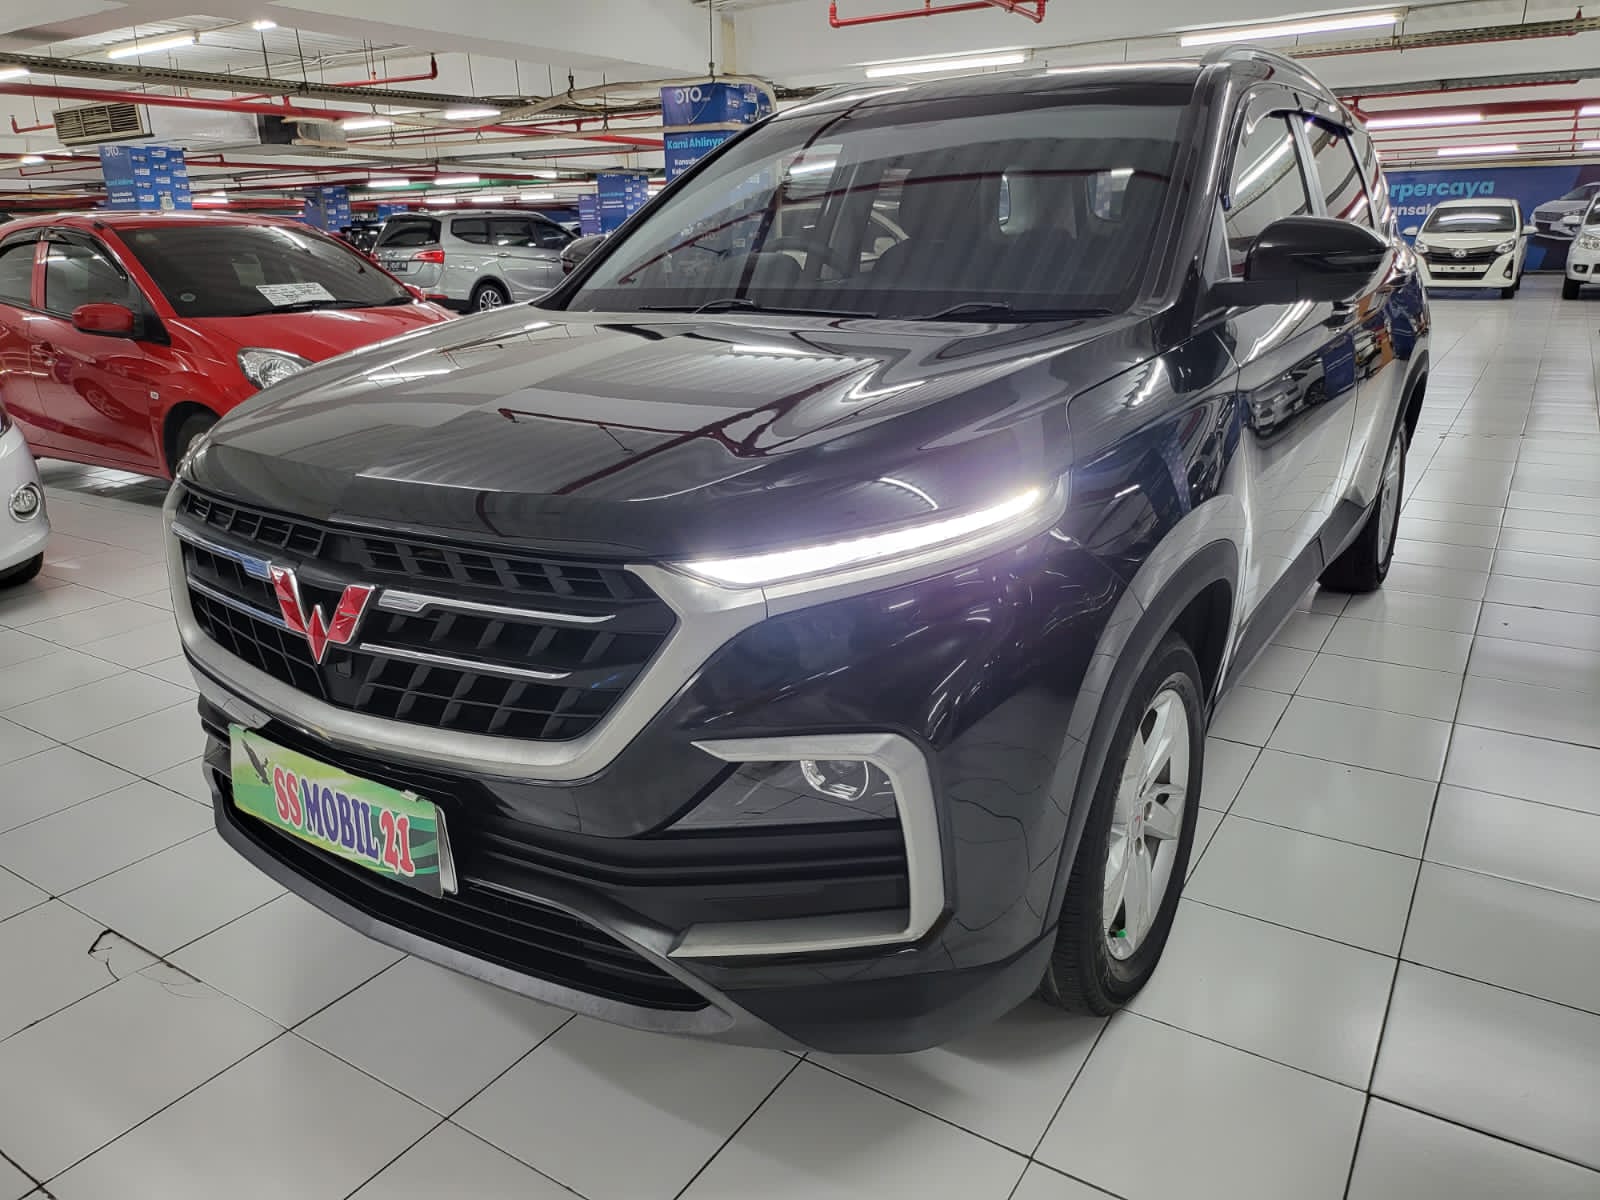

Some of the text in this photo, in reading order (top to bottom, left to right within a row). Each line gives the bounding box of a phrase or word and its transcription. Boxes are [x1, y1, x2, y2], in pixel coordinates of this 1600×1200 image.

[273, 767, 415, 877] SS MOBIL 21
